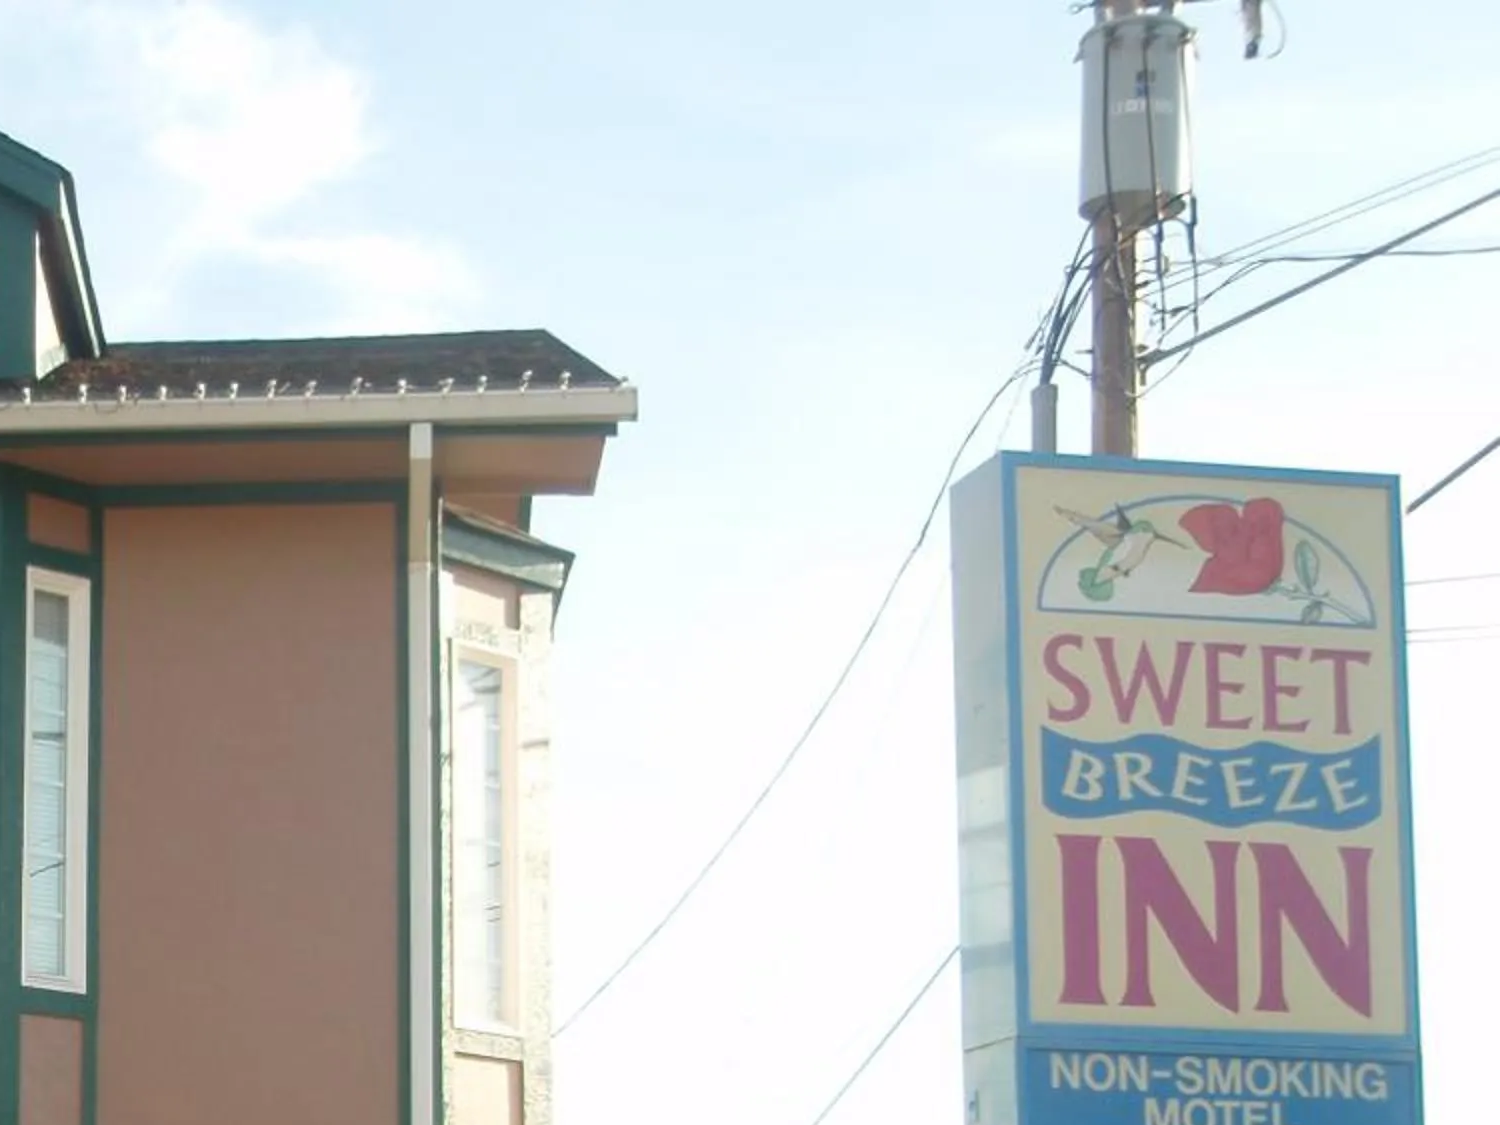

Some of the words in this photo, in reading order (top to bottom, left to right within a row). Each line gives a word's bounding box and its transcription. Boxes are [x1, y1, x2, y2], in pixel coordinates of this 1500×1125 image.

[1042, 633, 1372, 736] SWEET
[1060, 748, 1369, 815] BREEZE
[1054, 833, 1375, 1020] INN
[1050, 1052, 1389, 1101] NON-SMOKING
